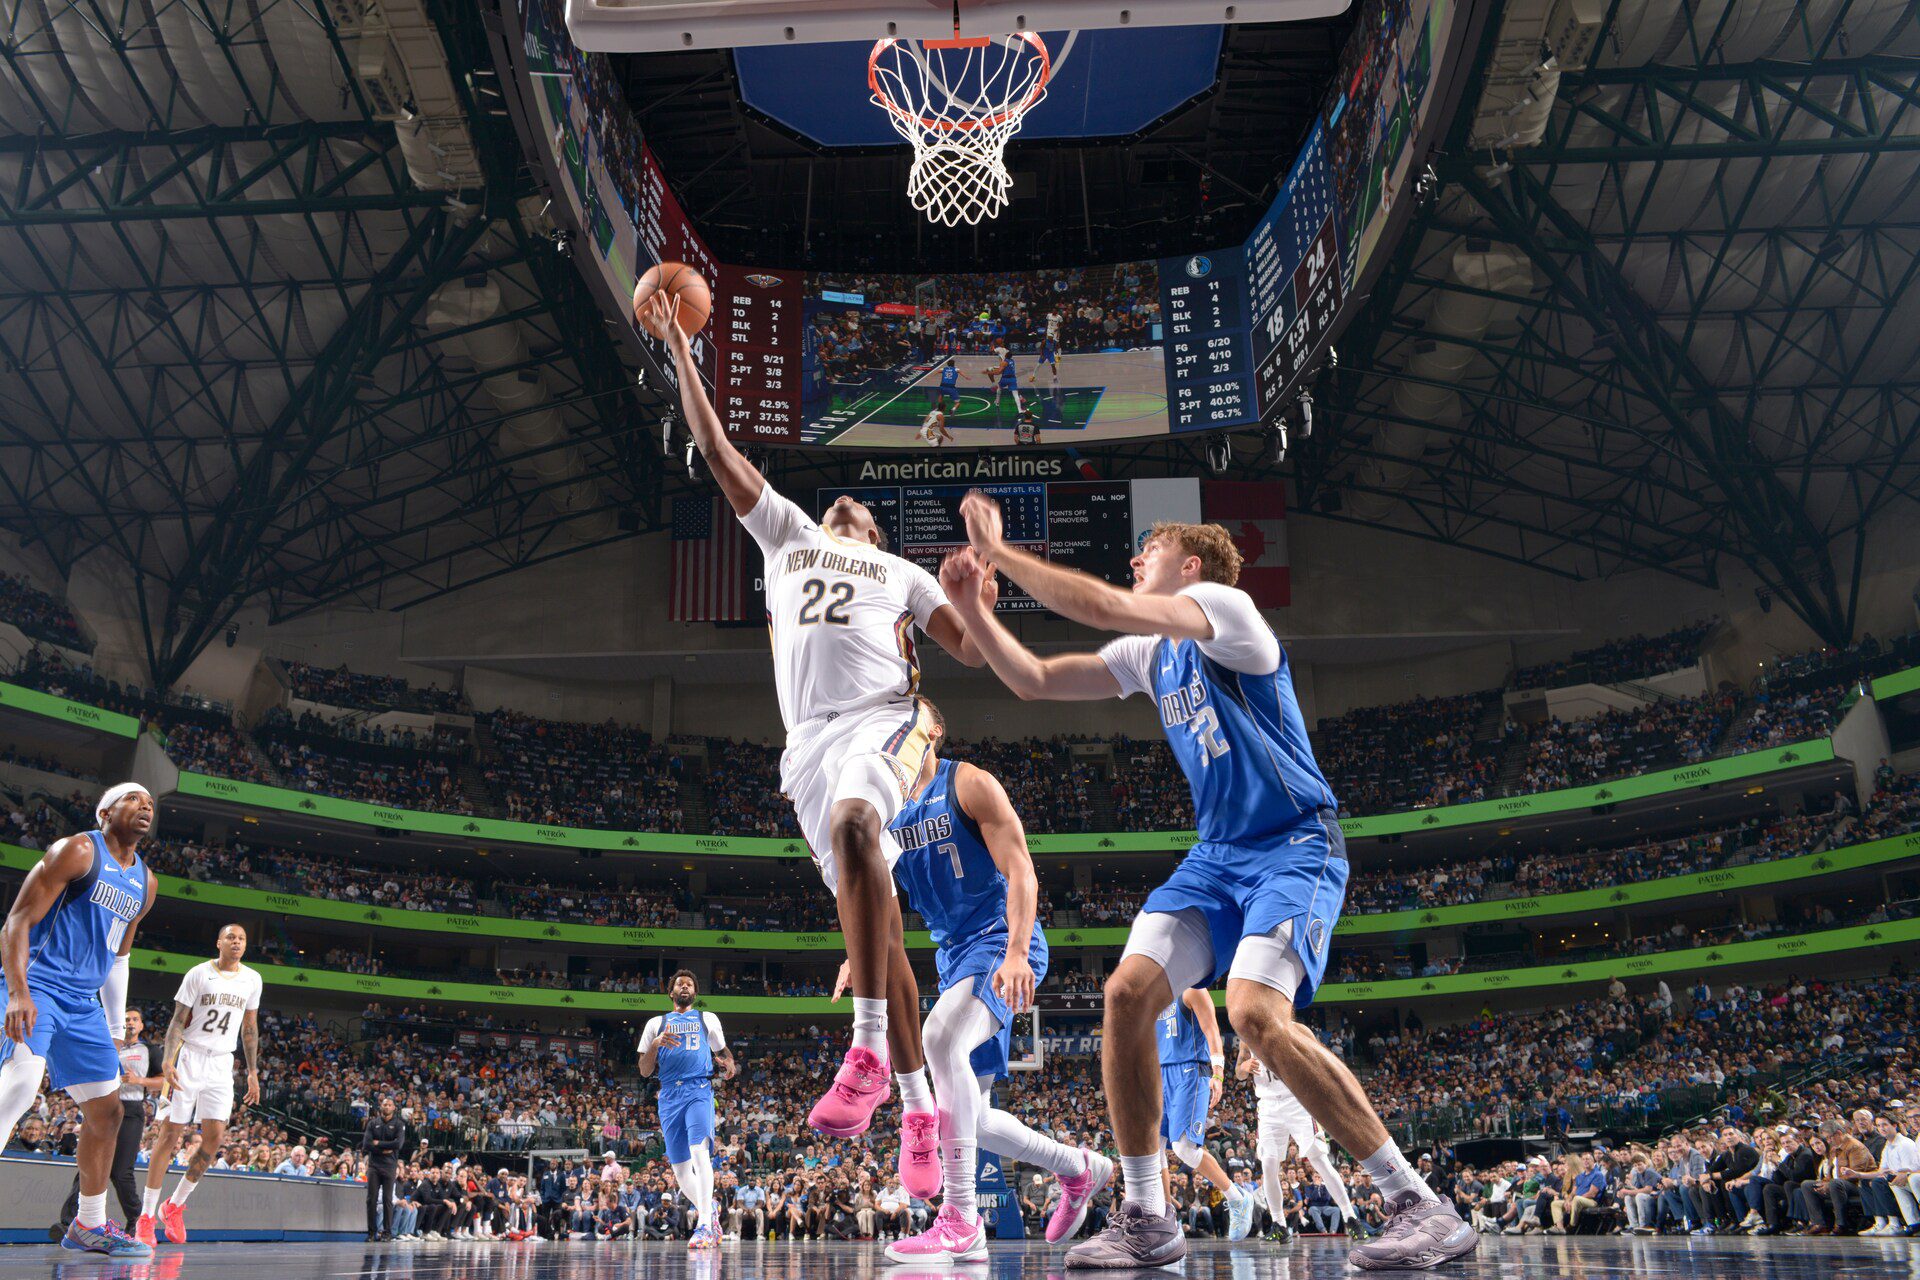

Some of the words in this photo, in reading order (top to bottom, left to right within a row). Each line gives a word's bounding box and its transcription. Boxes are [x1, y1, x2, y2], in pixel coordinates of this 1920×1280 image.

[1306, 239, 1325, 287] 24
[1171, 287, 1190, 295] REB
[1208, 281, 1219, 289] 11
[1316, 288, 1327, 307] TOL
[1328, 276, 1333, 290] 6
[733, 296, 751, 305] REB
[770, 300, 781, 308] 14
[1172, 300, 1185, 308] TO
[733, 309, 745, 317] TO
[1172, 311, 1191, 321] BLK
[1213, 307, 1219, 315] 2
[1319, 309, 1329, 330] FLS
[732, 321, 751, 330] BLK
[1174, 325, 1190, 333] STL
[1266, 305, 1284, 343] 18
[732, 333, 748, 342] STL
[1288, 310, 1310, 353] 1:31
[1175, 344, 1188, 352] FG
[1208, 337, 1230, 347] 6/20
[763, 355, 784, 363] 9/21
[1176, 355, 1197, 365] 3-PT
[1209, 350, 1231, 360] 4/10
[731, 365, 752, 374] 3-PT
[766, 368, 782, 376] 3/8
[1177, 369, 1188, 377] FT
[1213, 364, 1229, 373] 2/3
[1263, 364, 1275, 381] TOL
[1276, 354, 1281, 366] 6
[766, 380, 781, 389] 3/3
[1179, 389, 1191, 397] FG
[1209, 382, 1239, 393] 30.0%
[1265, 383, 1276, 402] FLS
[1278, 375, 1283, 388] 2
[730, 397, 742, 405] FG
[760, 400, 789, 409] 42.9%
[1180, 401, 1201, 410] 3-PT
[1210, 395, 1240, 406] 40.0%
[729, 410, 750, 419] 3-PT
[760, 413, 789, 422] 37.5%
[1181, 415, 1192, 423] FT
[1211, 409, 1242, 419] 66.7%
[729, 423, 740, 431] FT
[754, 425, 788, 435] 100.0%
[859, 458, 970, 481] American
[974, 456, 1062, 477] Airlines
[785, 549, 821, 575] NEW
[821, 551, 887, 584] ORLEANS
[799, 578, 856, 626] 22
[67, 705, 100, 721] PATRÓN
[1673, 767, 1711, 782] PATRÓN
[205, 781, 239, 793] PATRÓN
[924, 794, 946, 805] chime
[1498, 800, 1531, 811] PATRÓN
[373, 810, 404, 821] PATRÓN
[537, 829, 566, 838] PATRÓN
[1170, 835, 1199, 843] PATRÓN
[696, 839, 728, 848] PATRÓN
[938, 842, 964, 879] 7
[1698, 871, 1735, 885] PATRÓN
[90, 880, 141, 920] DALLAS
[266, 895, 299, 907] PATRÓN
[1505, 901, 1540, 911] PATRÓN
[447, 917, 479, 926] PATRÓN
[623, 930, 655, 939] PATRÓN
[797, 935, 827, 943] PATRÓN
[1777, 939, 1806, 950] PATRÓN
[200, 993, 217, 1006] NEW
[202, 1009, 231, 1035] 24
[669, 1022, 700, 1033] ALLAS
[1165, 1016, 1177, 1039] 31
[685, 1034, 700, 1050] 13
